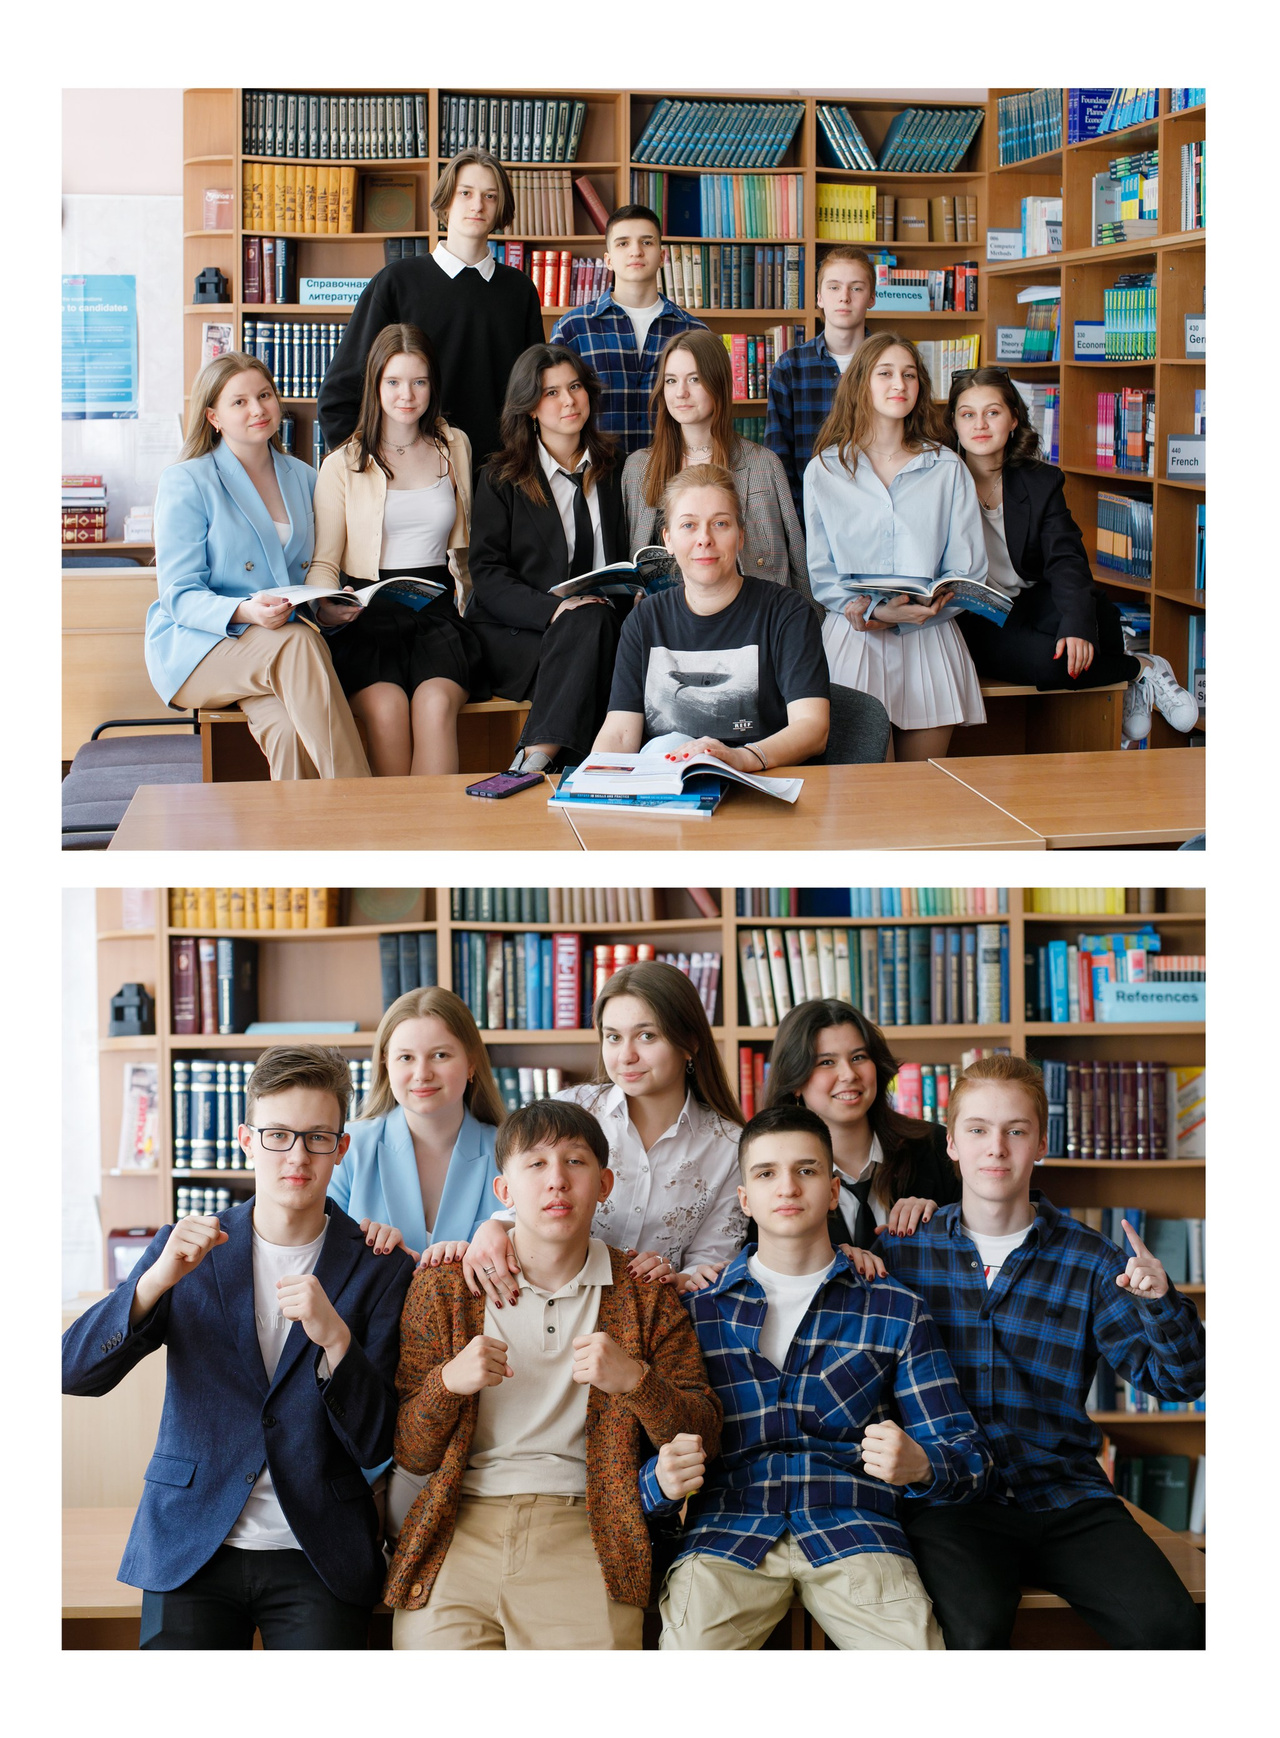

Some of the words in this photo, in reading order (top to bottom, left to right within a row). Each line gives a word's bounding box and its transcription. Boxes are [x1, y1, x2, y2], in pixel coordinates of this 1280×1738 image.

[1081, 96, 1111, 104] Foundation
[1086, 108, 1105, 116] Planne
[306, 279, 369, 289] Справочная
[308, 293, 361, 303] литератур
[67, 304, 76, 312] to
[78, 304, 129, 312] candidates
[1077, 341, 1106, 349] Econom
[1171, 457, 1199, 467] French
[1116, 991, 1199, 1003] References
